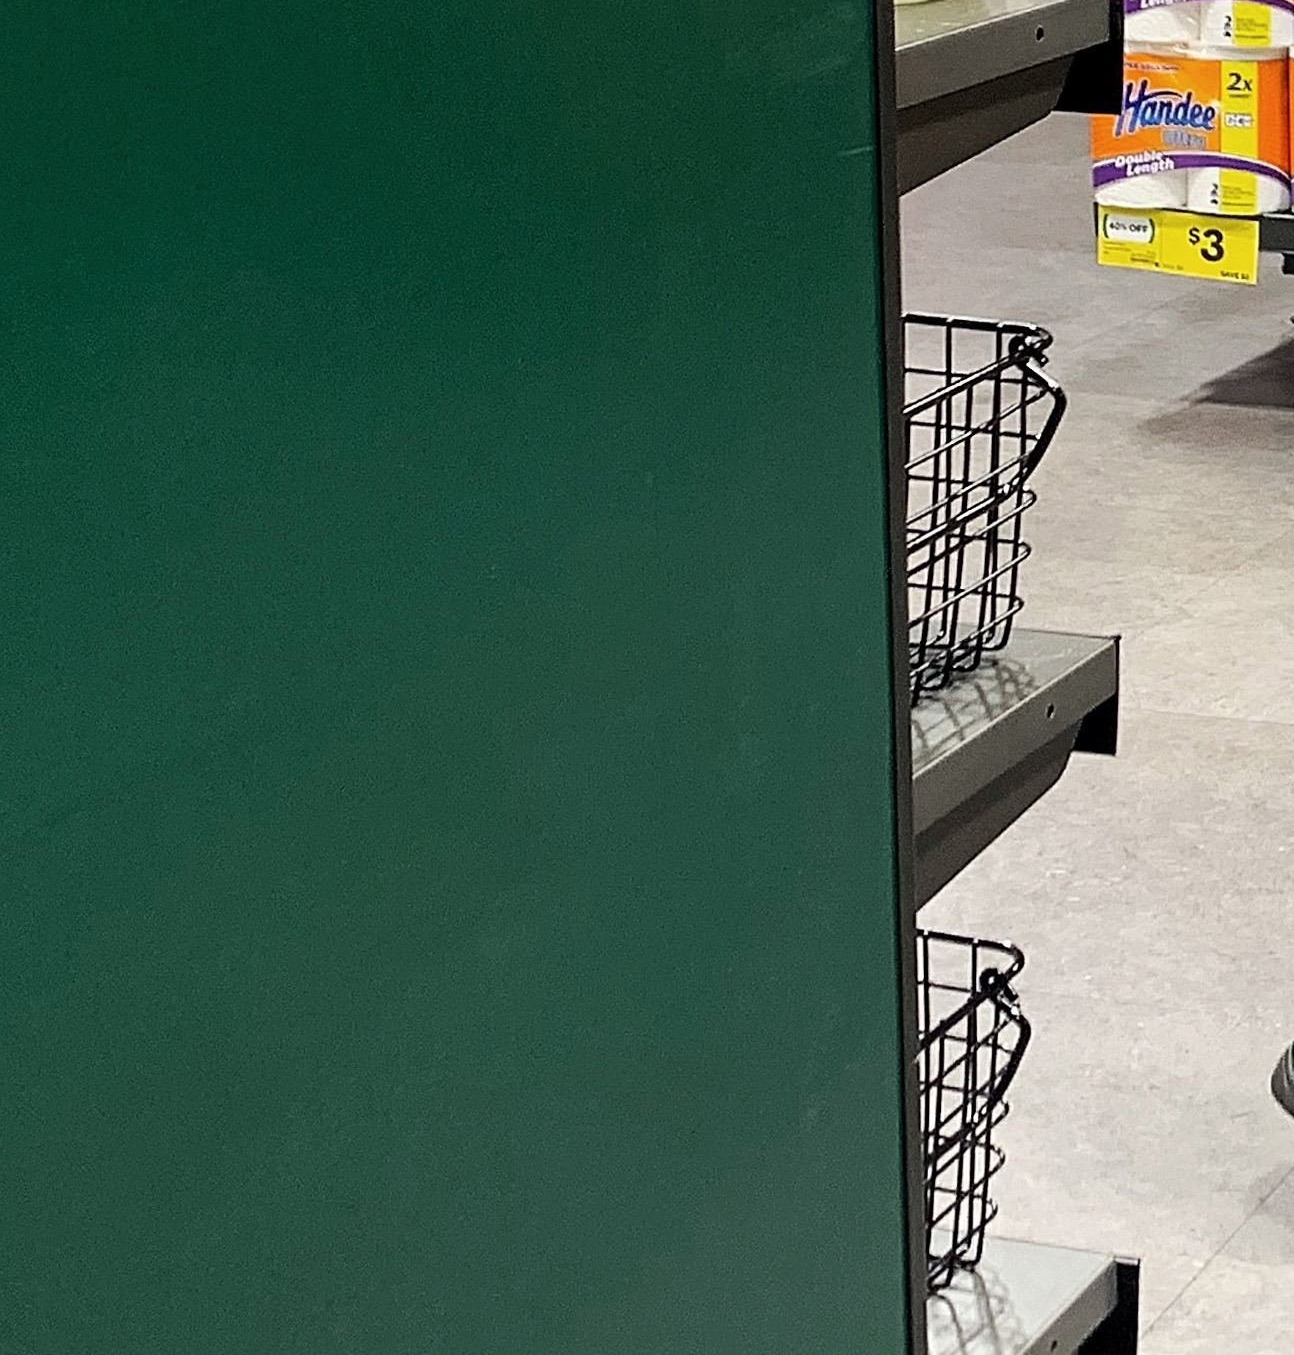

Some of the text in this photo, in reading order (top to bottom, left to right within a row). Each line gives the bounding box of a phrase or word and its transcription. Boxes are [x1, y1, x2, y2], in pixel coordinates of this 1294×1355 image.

[1226, 72, 1253, 93] 2x
[1114, 79, 1216, 138] Handee
[1114, 150, 1164, 169] Double
[1126, 158, 1176, 177] Length
[1129, 224, 1148, 233] OFF
[1188, 226, 1225, 262] $3
